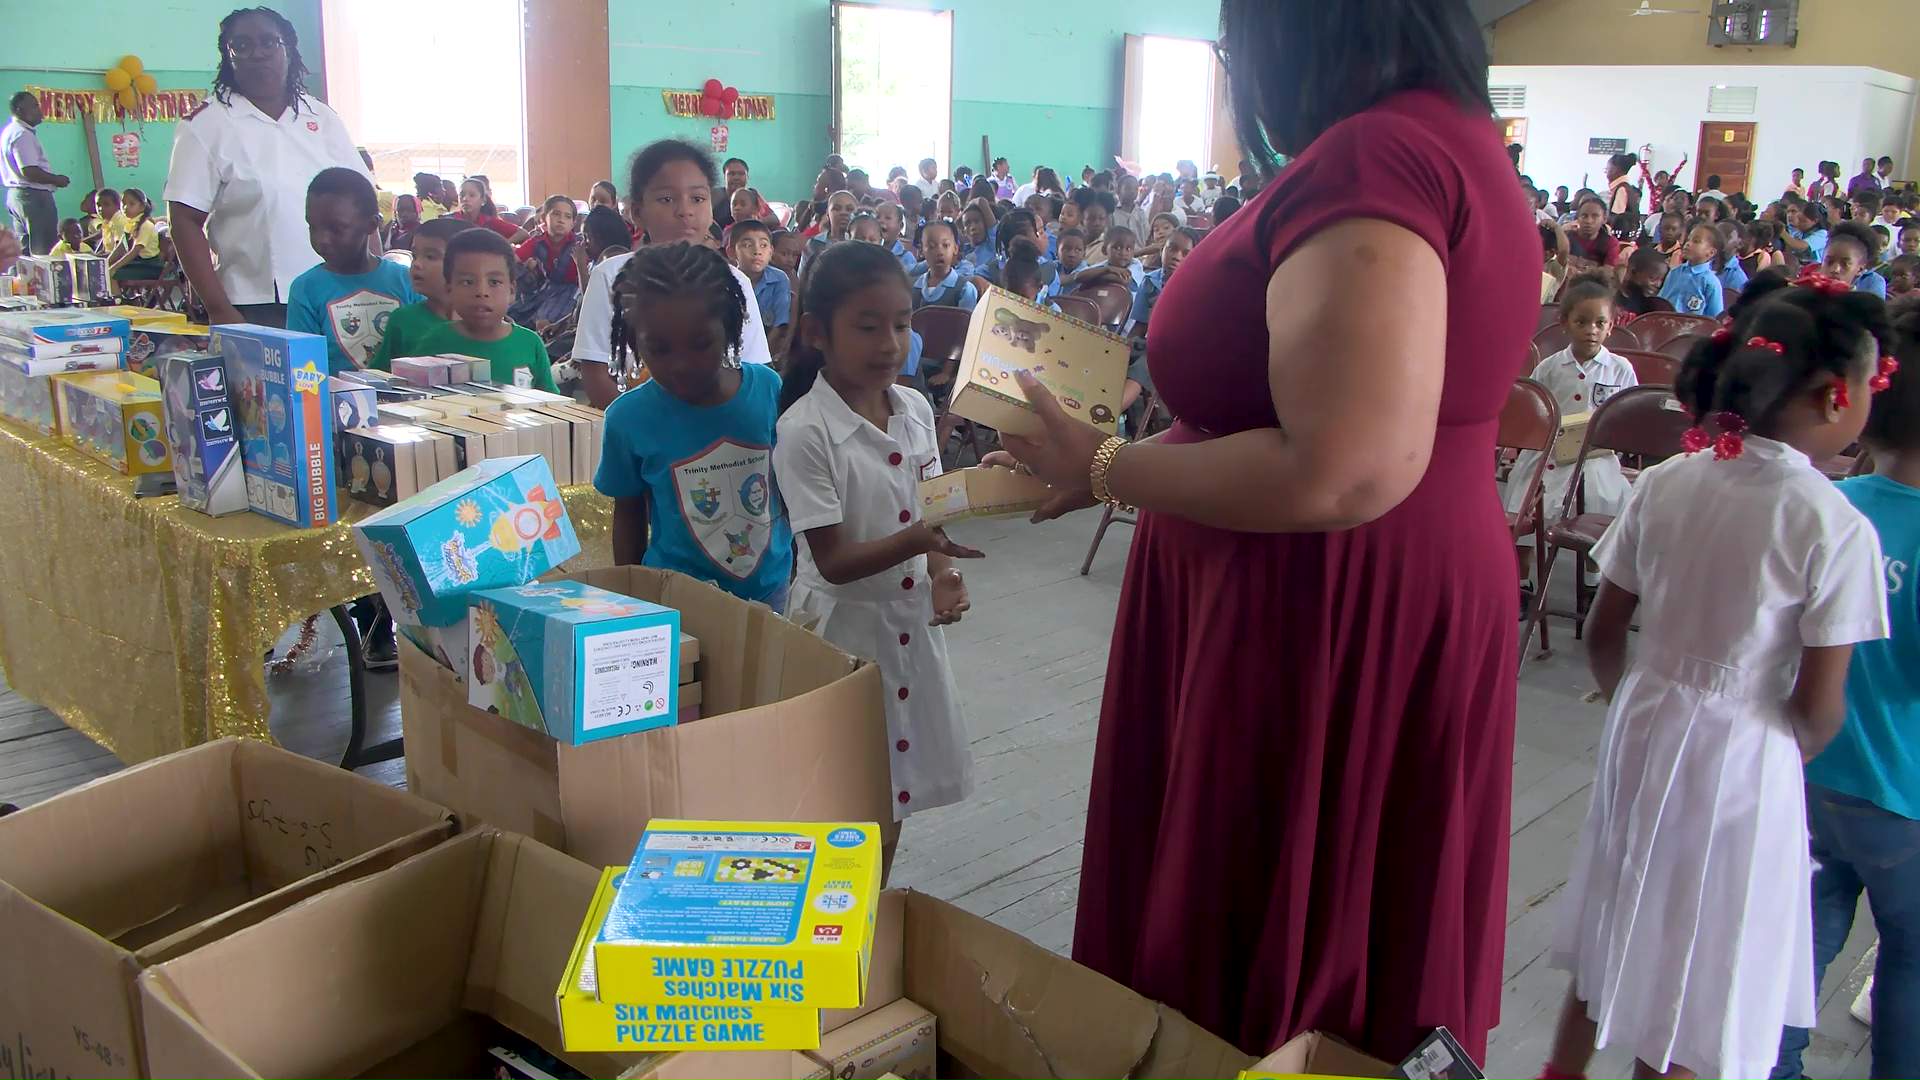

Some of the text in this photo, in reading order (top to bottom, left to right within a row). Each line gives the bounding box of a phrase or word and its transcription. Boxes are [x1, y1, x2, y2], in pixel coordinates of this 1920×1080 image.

[264, 347, 281, 368] BIG
[296, 370, 323, 384] BABY
[684, 465, 709, 475] Trinity
[709, 459, 746, 472] Methodist
[310, 443, 325, 521] BIG BUBBLE
[652, 957, 804, 979] PUZZLE GAME
[664, 981, 805, 1002] Six Matches
[615, 1003, 753, 1021] Six Matches
[616, 1023, 765, 1043] PUZZLE GAME
